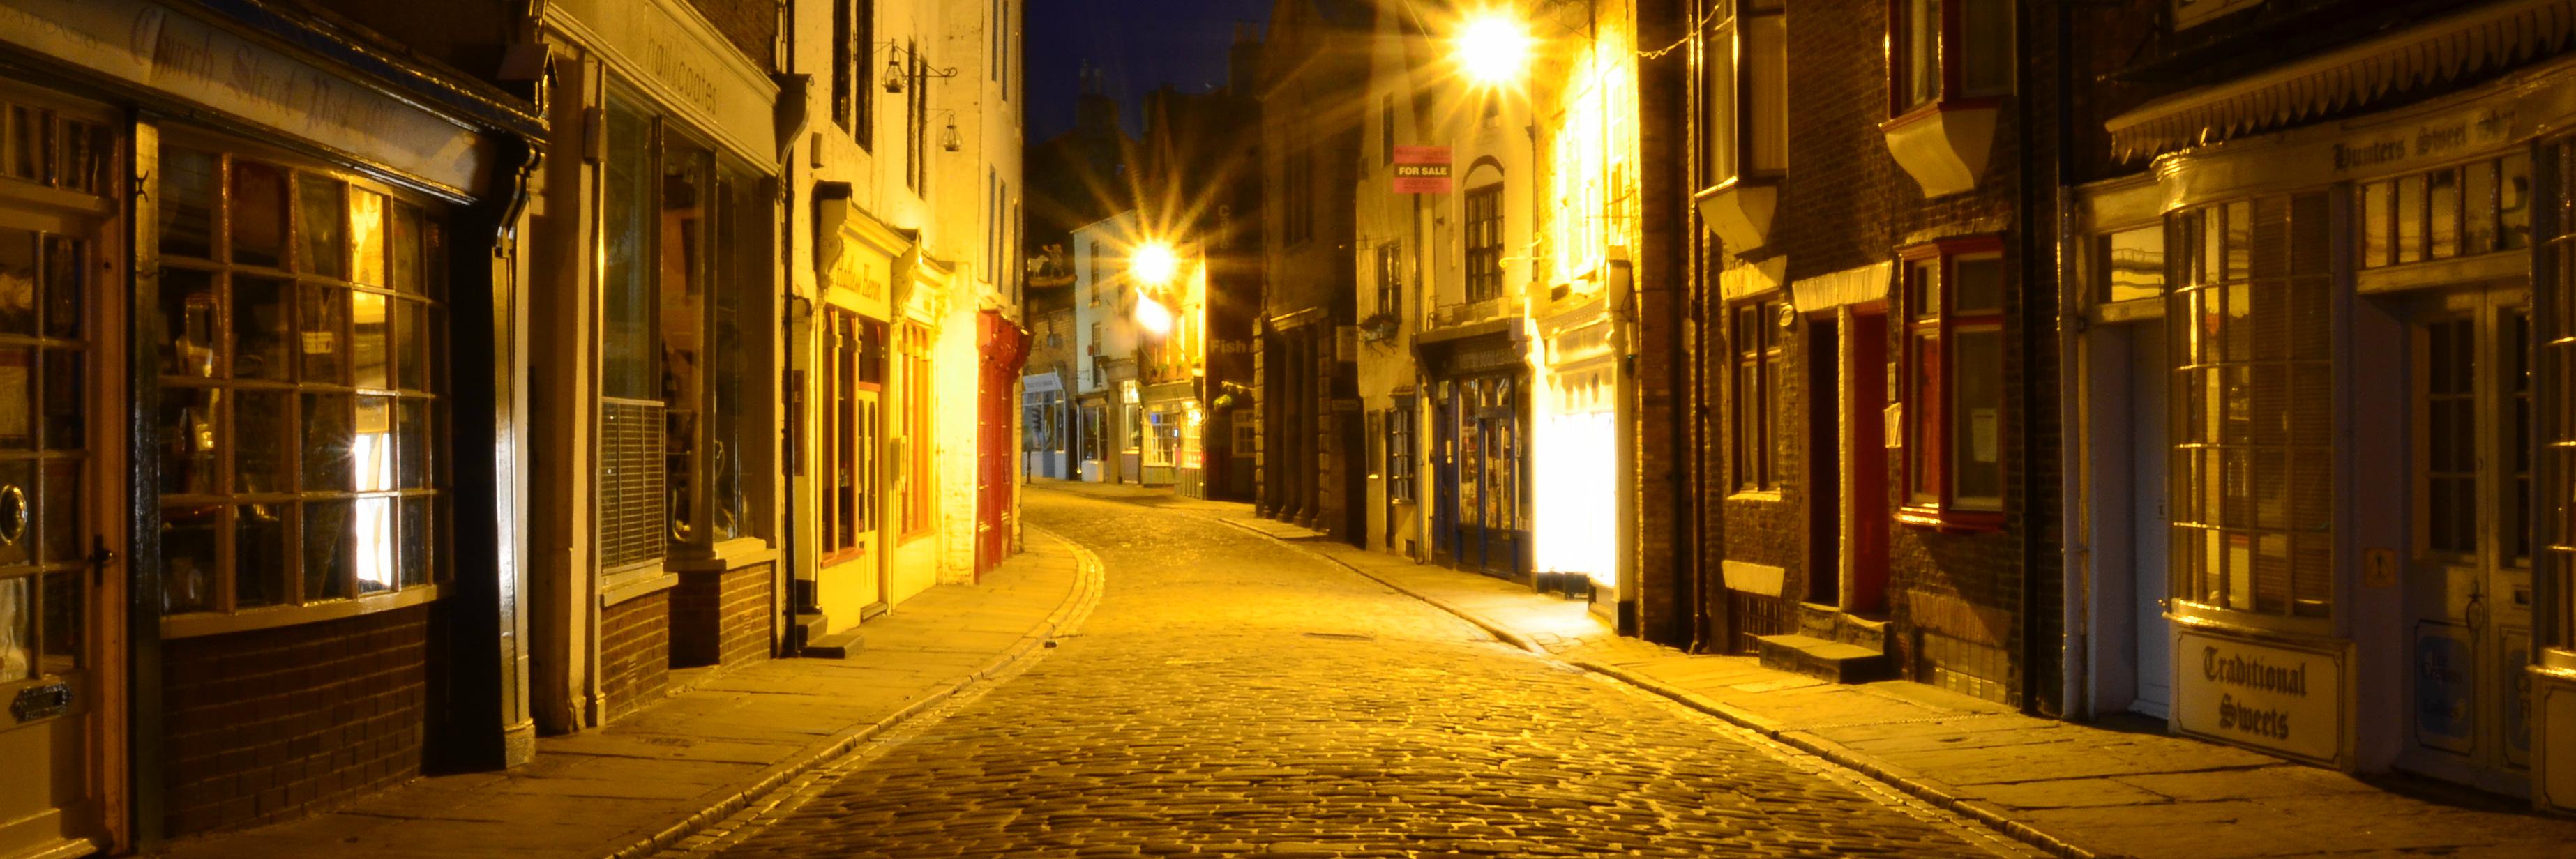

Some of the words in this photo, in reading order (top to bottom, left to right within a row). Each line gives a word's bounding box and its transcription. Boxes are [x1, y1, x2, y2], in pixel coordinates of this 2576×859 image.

[130, 6, 214, 91] Church
[2332, 137, 2406, 172] Hunters
[2416, 121, 2467, 155] Sweet
[1399, 167, 1419, 176] FOR
[1421, 167, 1447, 176] SALE
[1210, 339, 1246, 354] Fish
[2202, 645, 2307, 698] Traditional
[2218, 692, 2289, 740] Sweets
